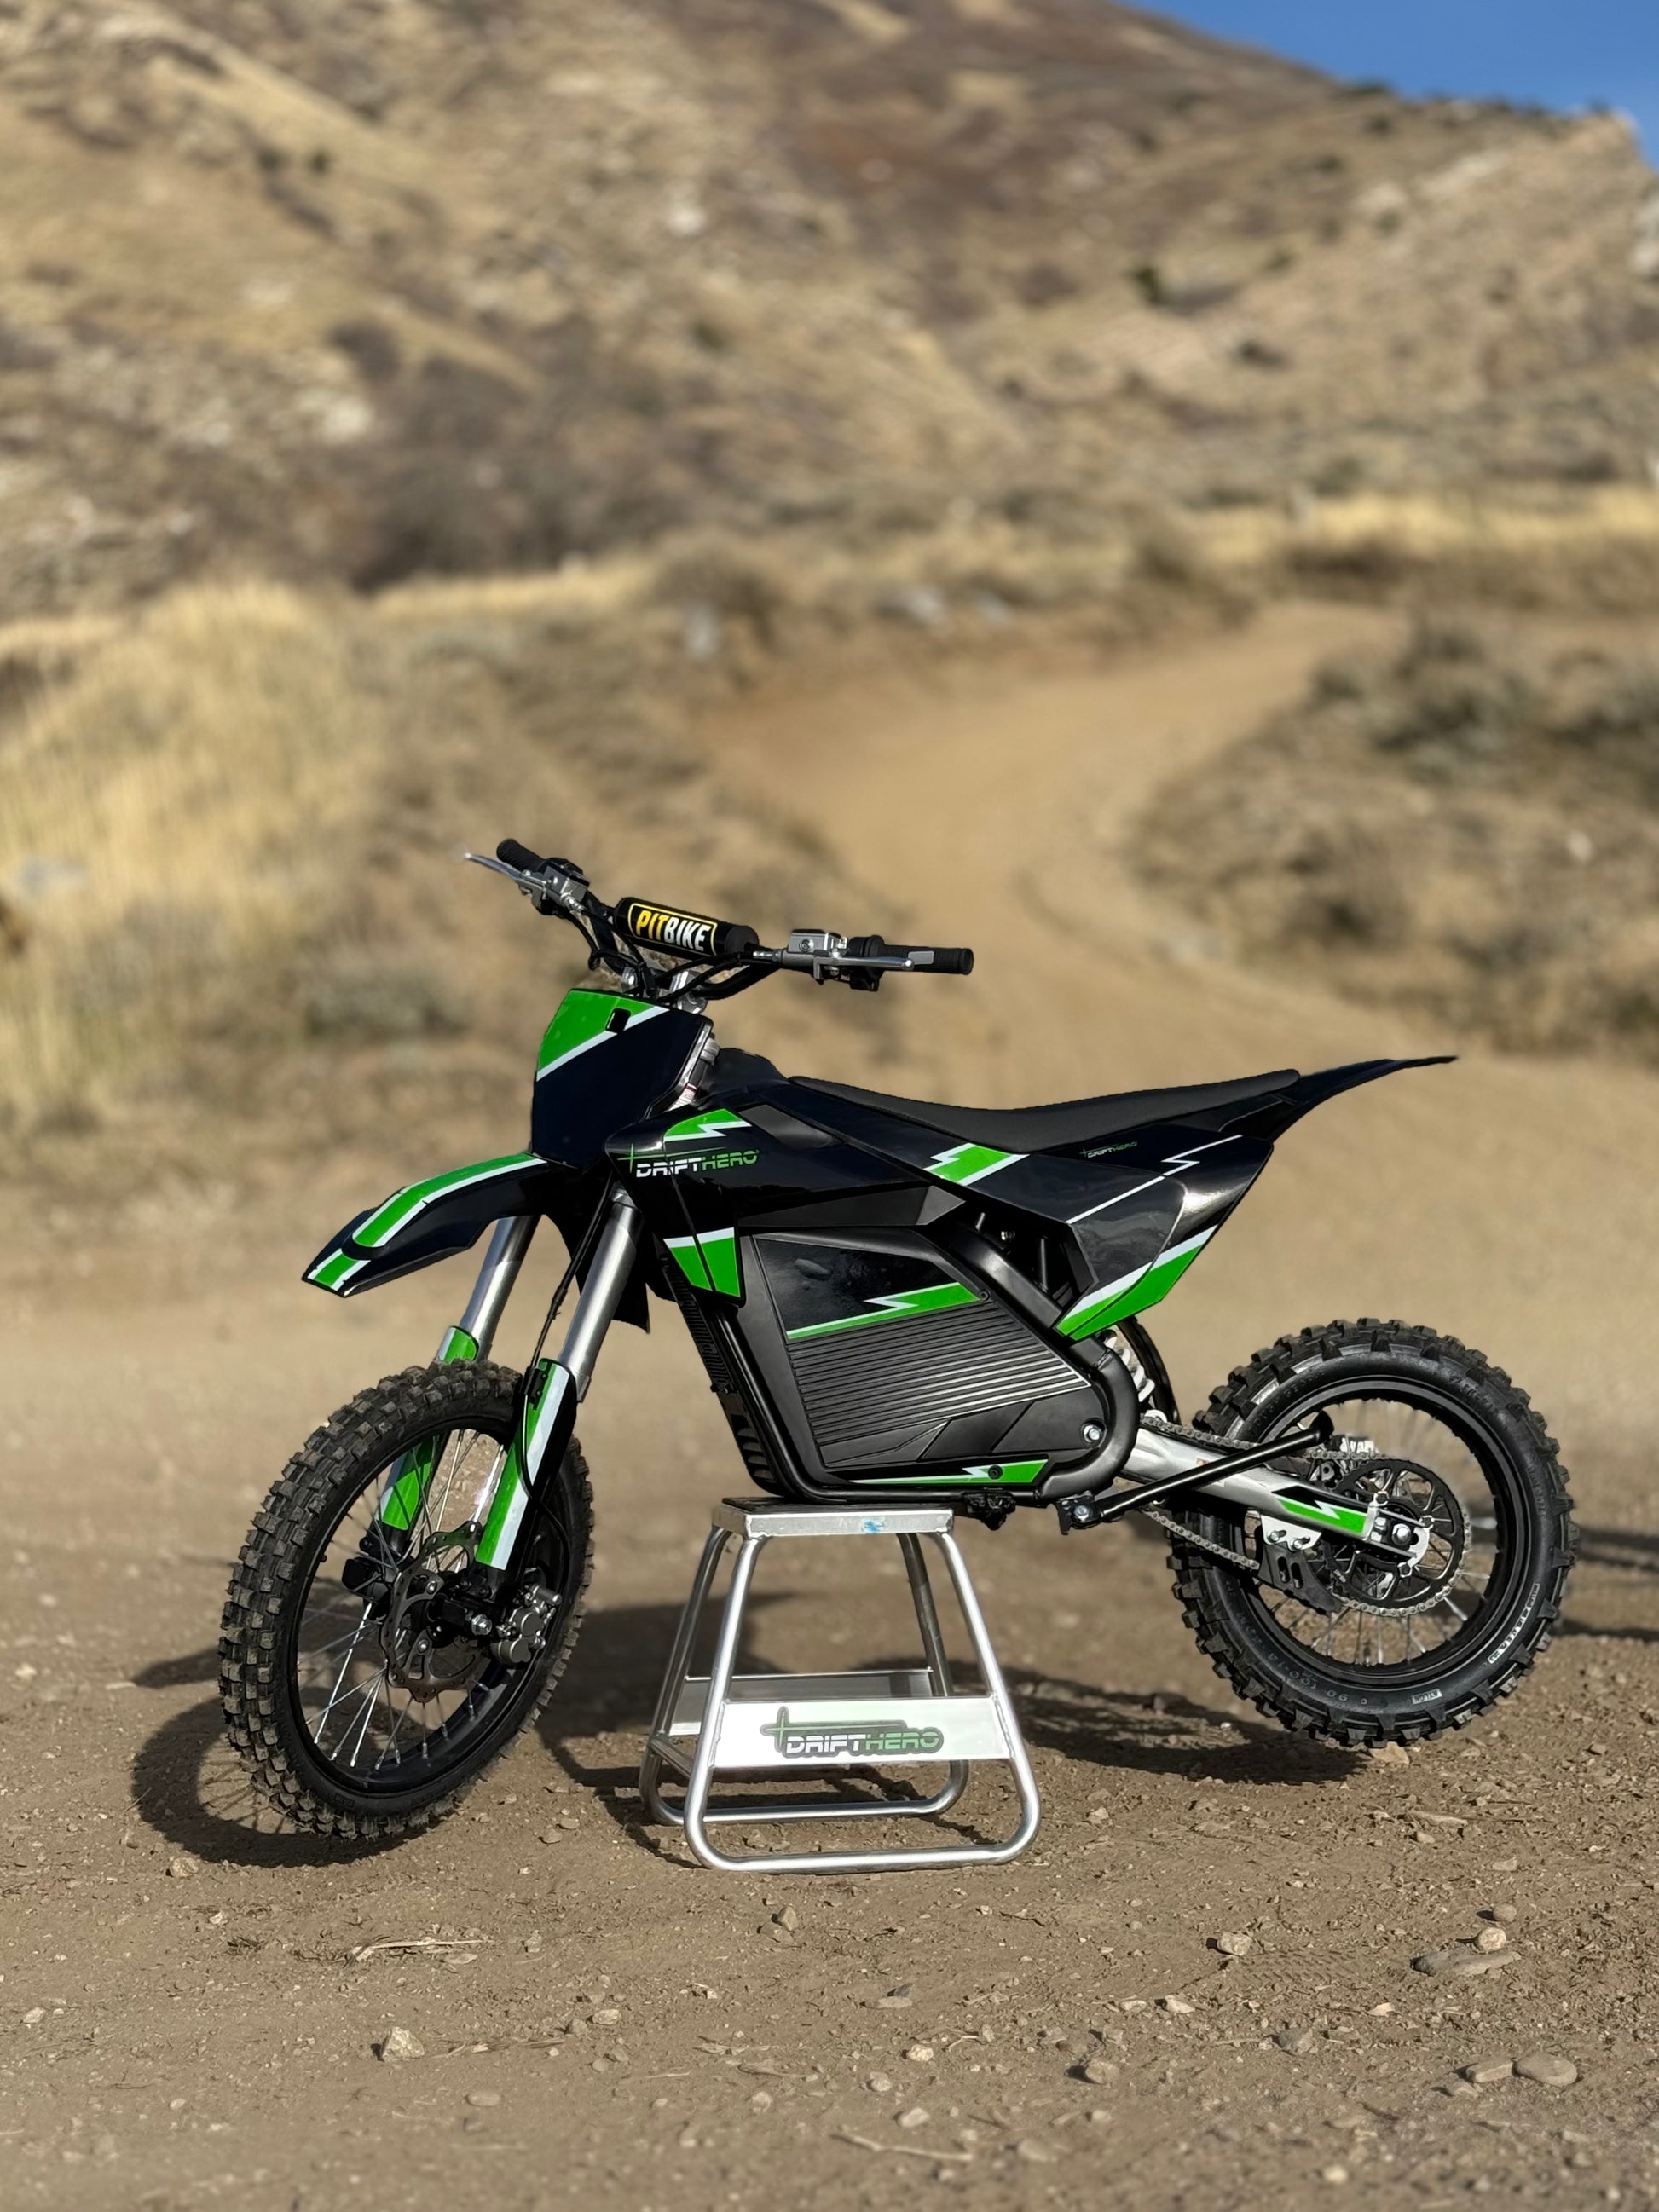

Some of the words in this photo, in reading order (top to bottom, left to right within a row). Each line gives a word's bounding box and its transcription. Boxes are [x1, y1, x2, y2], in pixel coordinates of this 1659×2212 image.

[636, 910, 712, 951] PITBIKE
[636, 1151, 757, 1177] DRIFTHERO
[786, 1731, 939, 1753] DRIFTHERO
